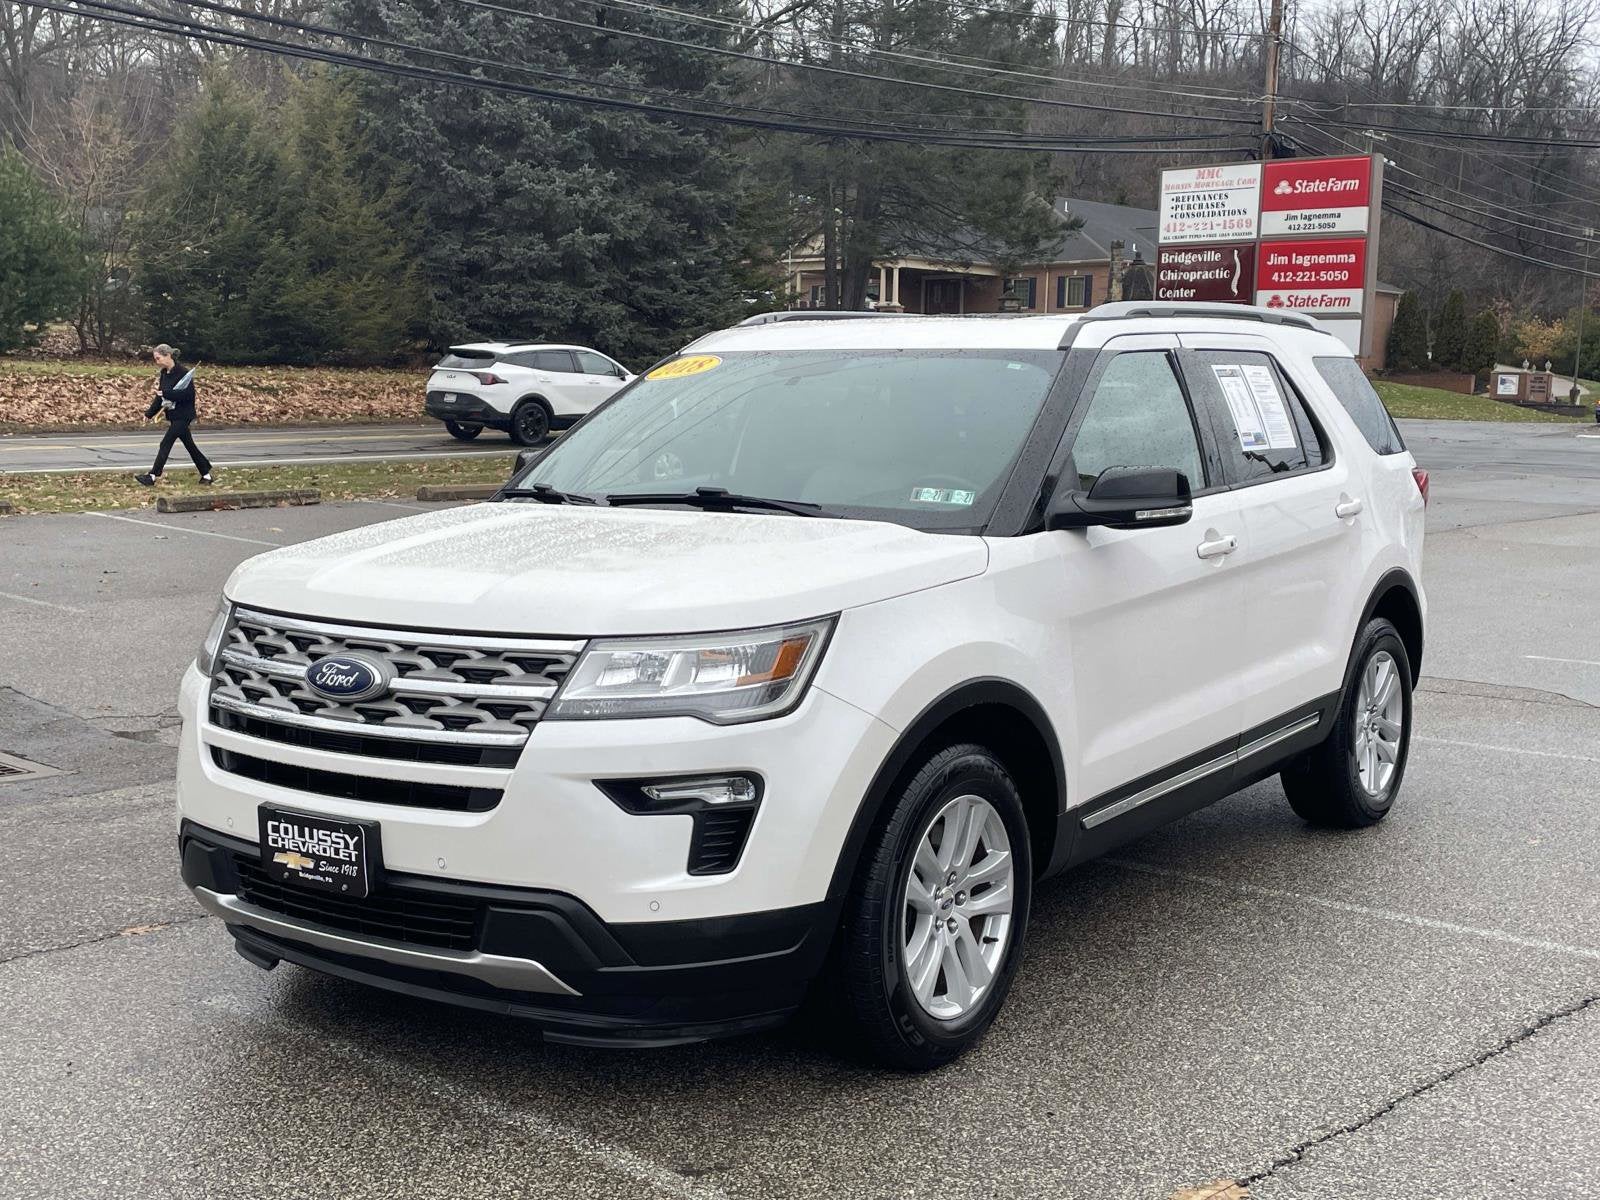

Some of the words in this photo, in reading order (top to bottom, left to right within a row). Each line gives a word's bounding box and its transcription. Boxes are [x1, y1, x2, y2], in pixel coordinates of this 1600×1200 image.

[1196, 168, 1223, 179] MMC
[1294, 177, 1360, 194] StateFarm
[1175, 193, 1229, 203] REFINANCES
[1175, 201, 1226, 211] PURCHASES
[1174, 208, 1247, 220] CONSOLIDATIONS
[1284, 213, 1298, 221] Jim
[1300, 212, 1341, 222] Iagnemma
[1288, 222, 1336, 231] 412-221-5050
[1161, 250, 1222, 265] Bridgeville
[1266, 253, 1289, 266] Jim
[1292, 253, 1356, 267] Iagnemma
[1160, 267, 1230, 282] Chiropractic
[1272, 270, 1349, 283] 412-221-5050
[1159, 287, 1196, 299] Center
[1286, 294, 1351, 308] StateFarm
[315, 662, 359, 687] Ford
[267, 820, 359, 850] COLUSSY
[268, 835, 359, 862] CHEVROLET
[318, 861, 340, 874] Since
[341, 864, 358, 877] 1918
